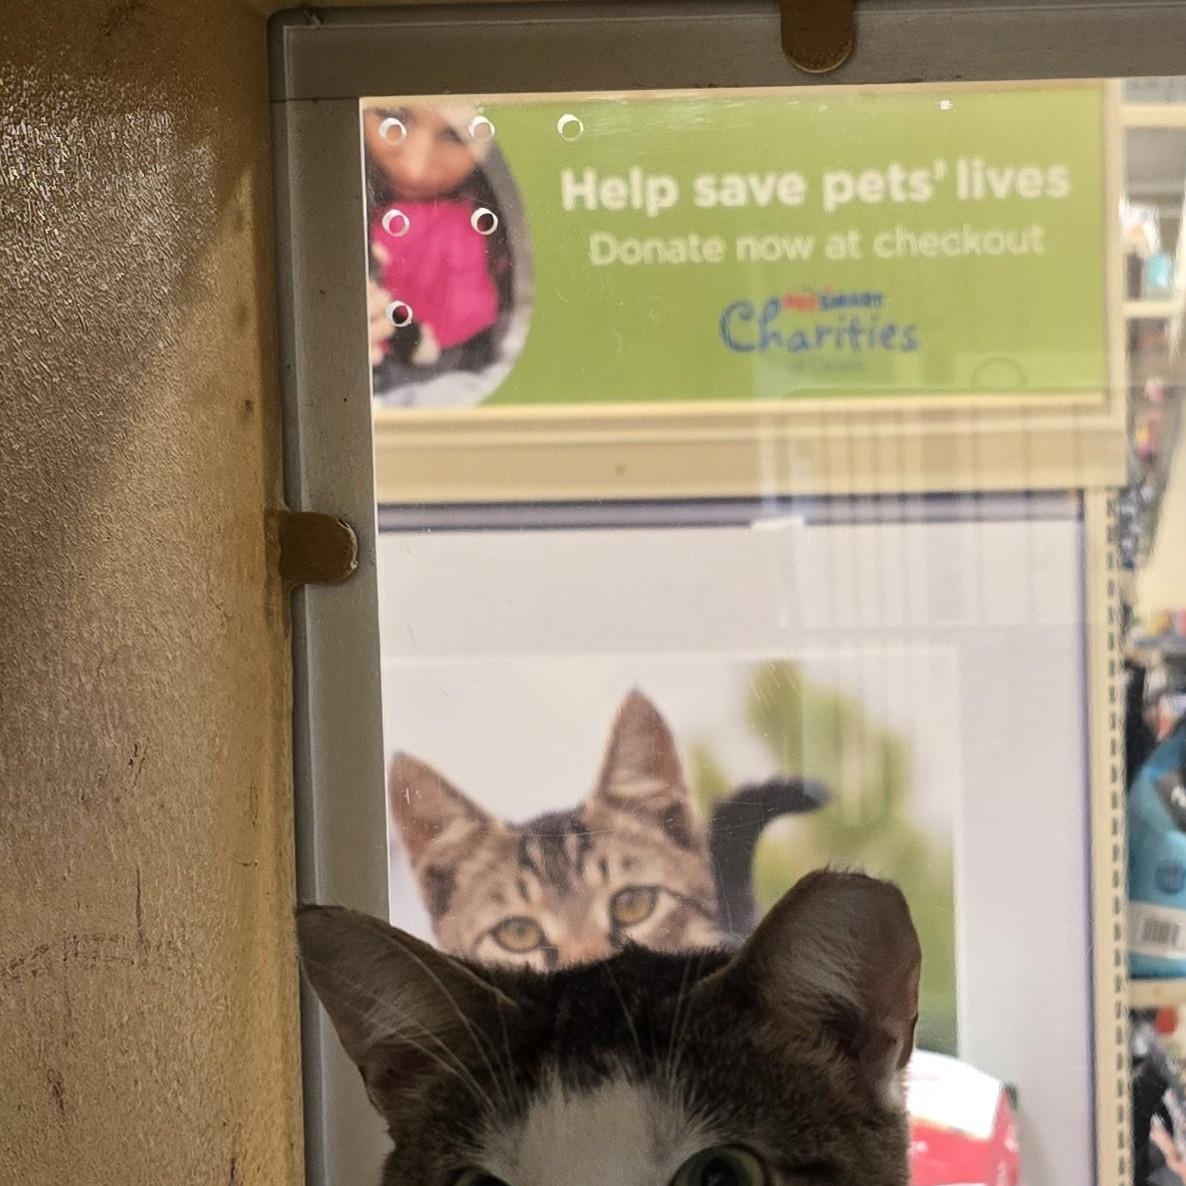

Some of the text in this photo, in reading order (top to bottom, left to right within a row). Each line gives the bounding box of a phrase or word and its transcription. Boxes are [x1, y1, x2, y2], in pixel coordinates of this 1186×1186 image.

[561, 167, 679, 216] Help
[693, 172, 807, 207] save
[956, 157, 1070, 200] lives
[588, 224, 1046, 266] Donate now at checkout
[718, 297, 918, 353] Charities
